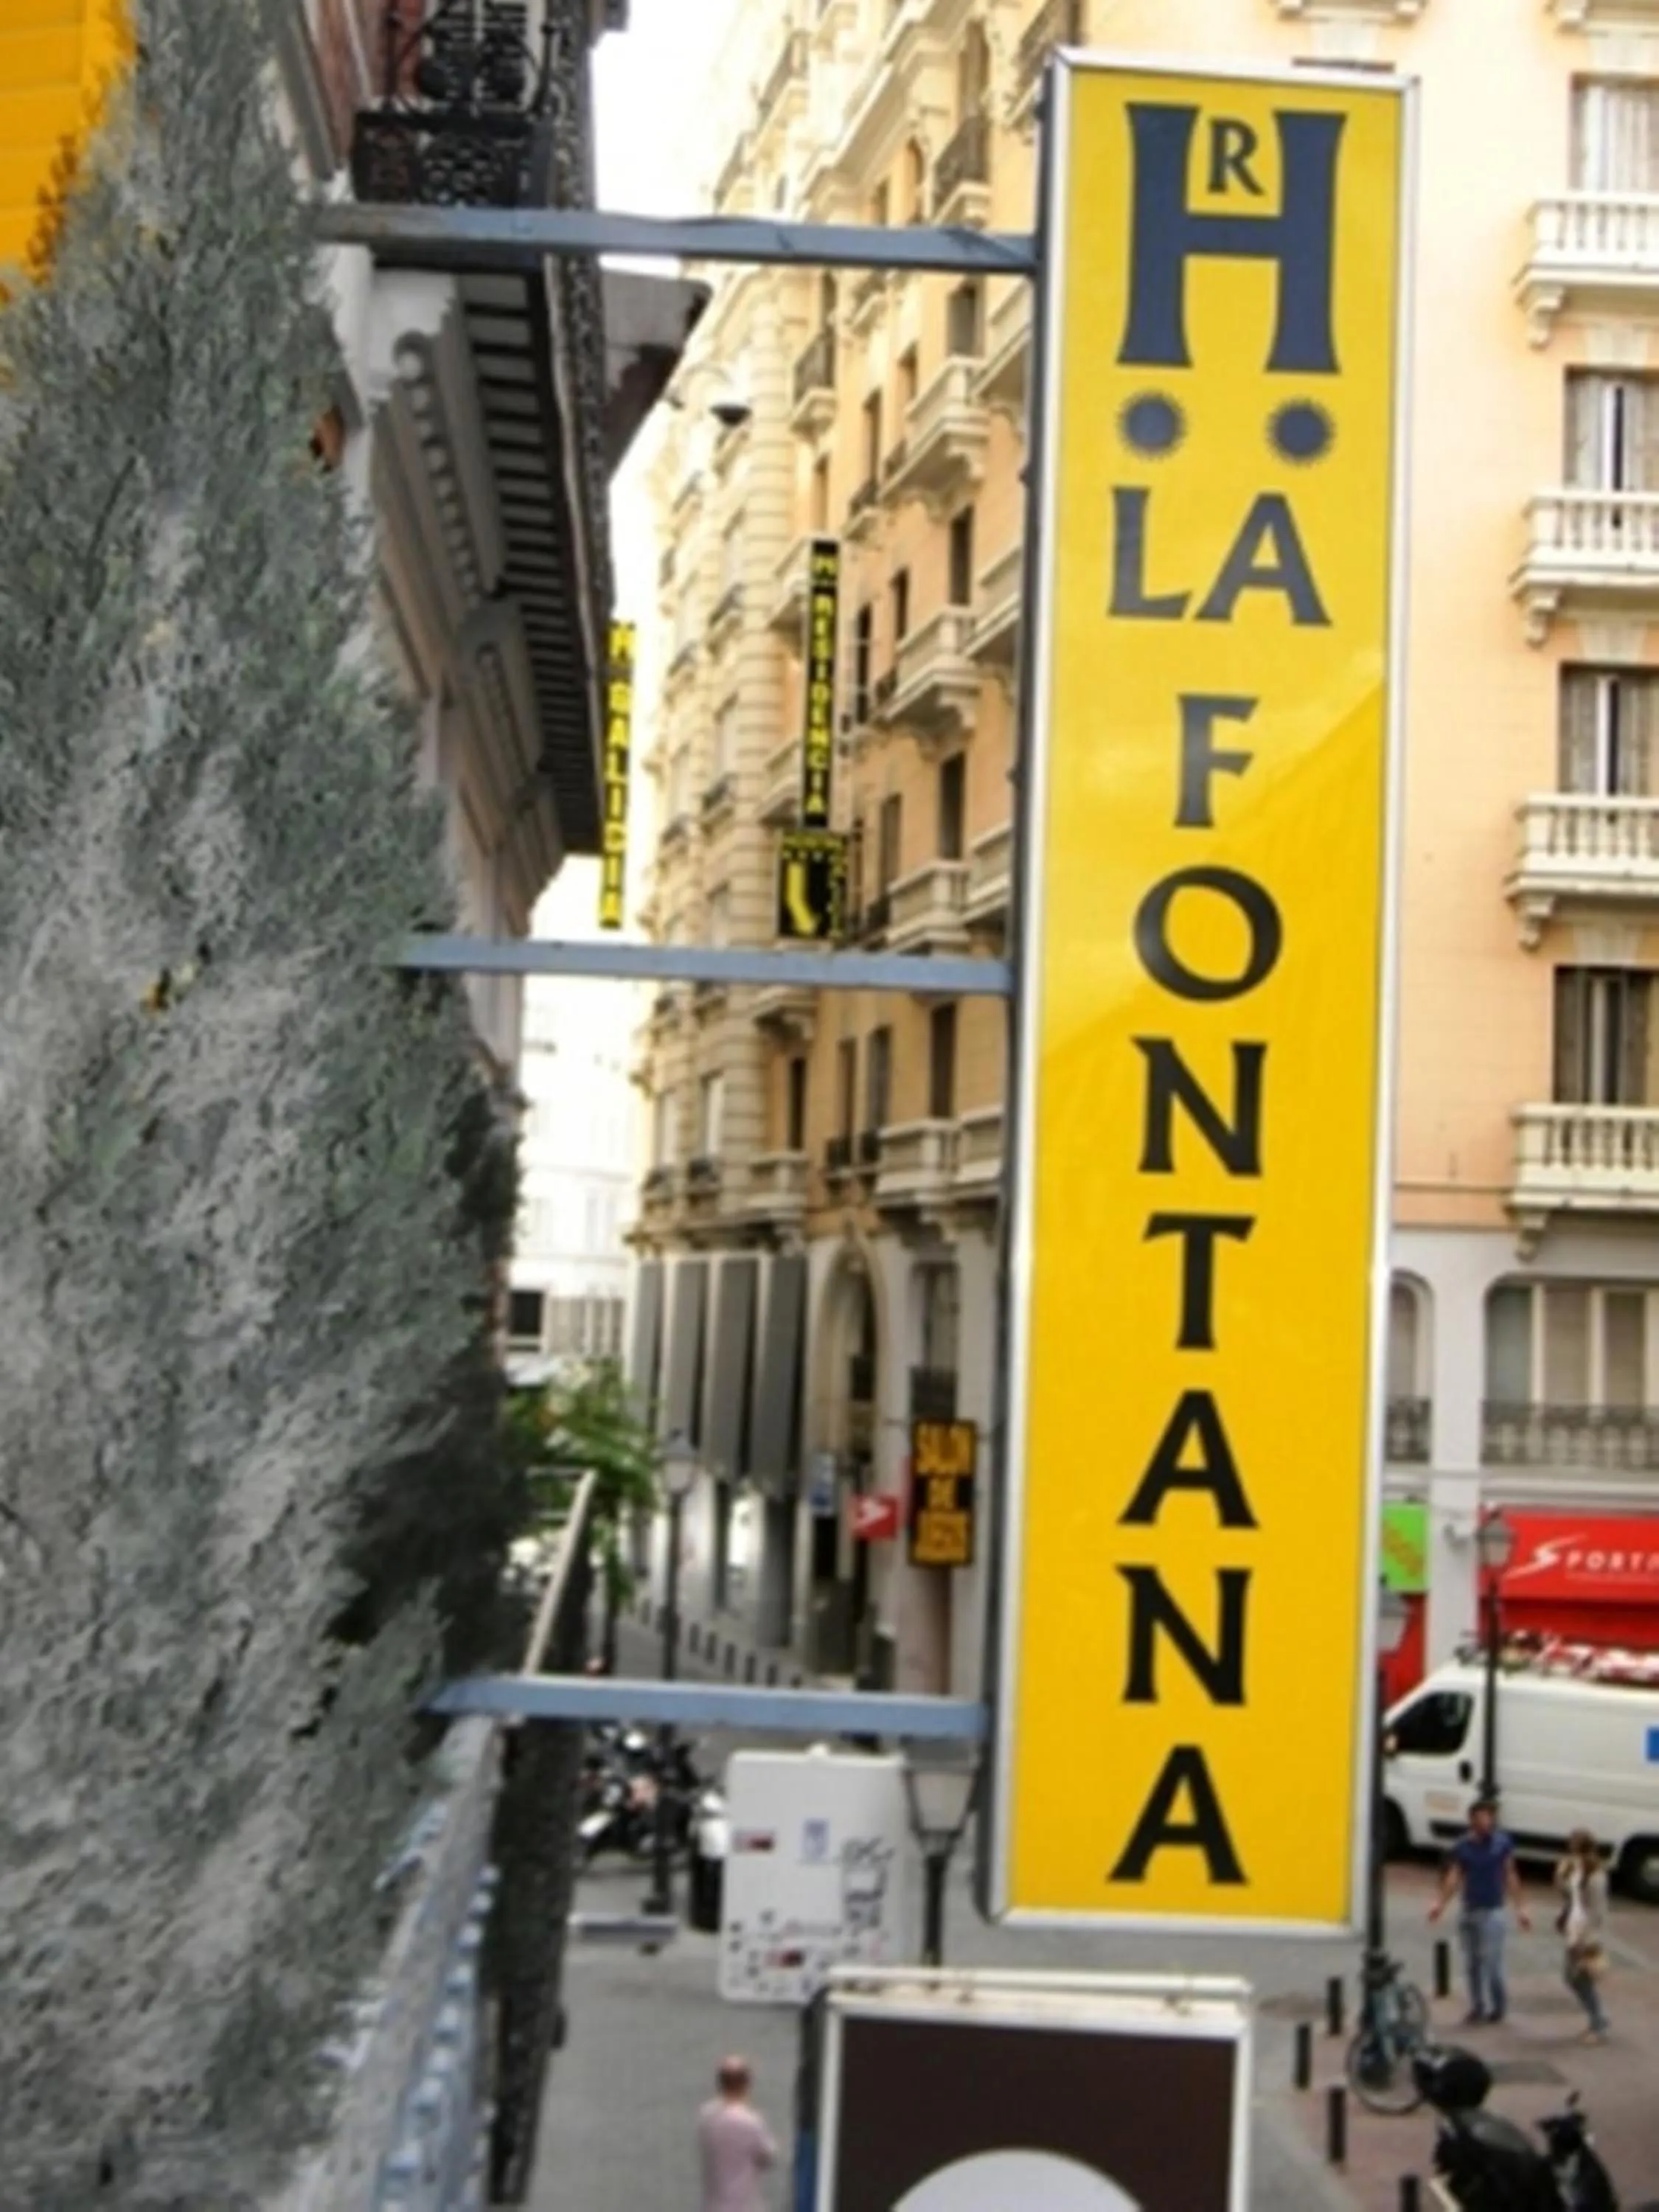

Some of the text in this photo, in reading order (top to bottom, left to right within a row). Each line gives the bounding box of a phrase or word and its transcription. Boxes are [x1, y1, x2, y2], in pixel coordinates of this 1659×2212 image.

[1116, 102, 1346, 375] H
[1207, 116, 1264, 196] R
[1108, 486, 1332, 627] LA
[808, 594, 835, 815] RESIDENCIA
[1107, 693, 1283, 1885] FONTANA
